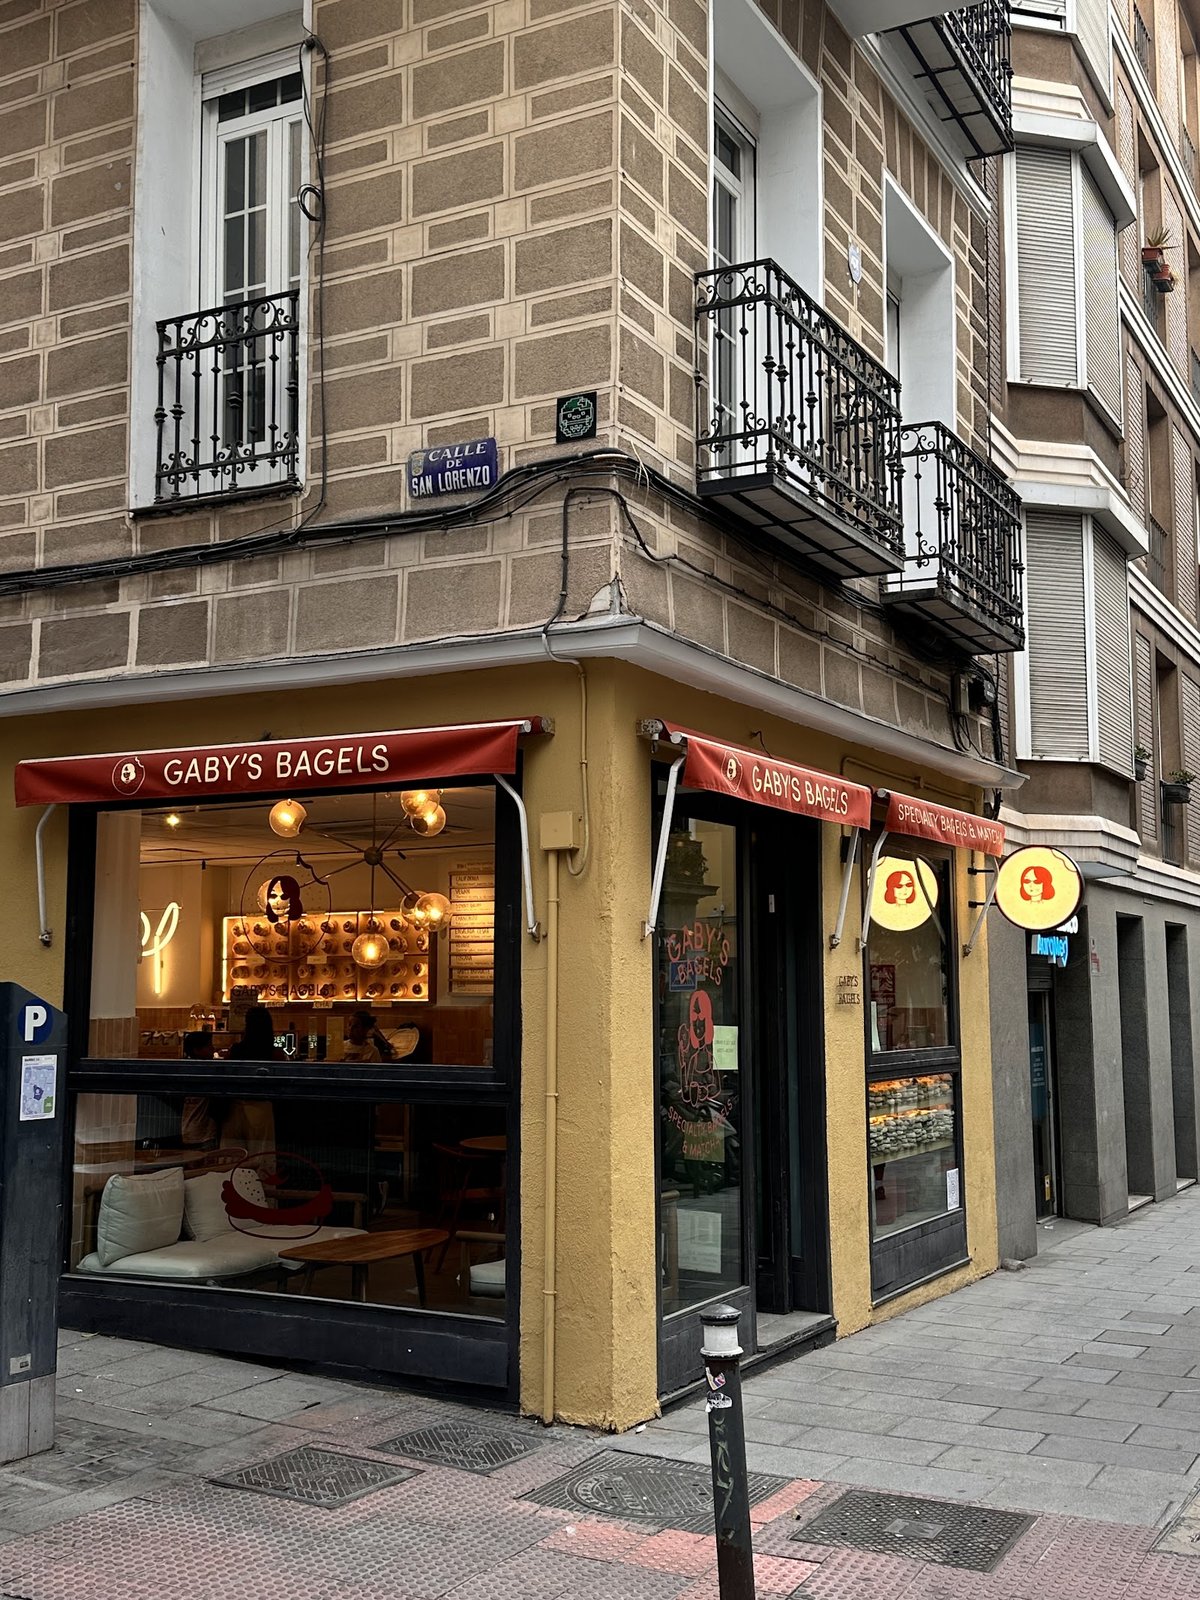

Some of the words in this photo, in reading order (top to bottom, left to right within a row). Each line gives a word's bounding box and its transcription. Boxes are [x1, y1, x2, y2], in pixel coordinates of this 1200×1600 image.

[428, 442, 488, 461] CALLE
[446, 458, 463, 469] DE
[411, 476, 433, 497] SAN
[438, 465, 491, 493] LORENZO
[163, 752, 263, 785] GABY'S
[275, 744, 389, 778] BAGELS
[752, 765, 801, 803] GABY'S
[805, 782, 849, 816] BAGELS
[898, 804, 939, 830] SPECIALTY
[941, 815, 967, 837] BAGELS
[968, 823, 977, 839] &
[667, 921, 730, 966] GABY'S
[677, 955, 723, 986] BAGELS
[232, 984, 276, 997] GABY'S
[25, 1005, 47, 1041] P
[682, 1140, 688, 1154] &
